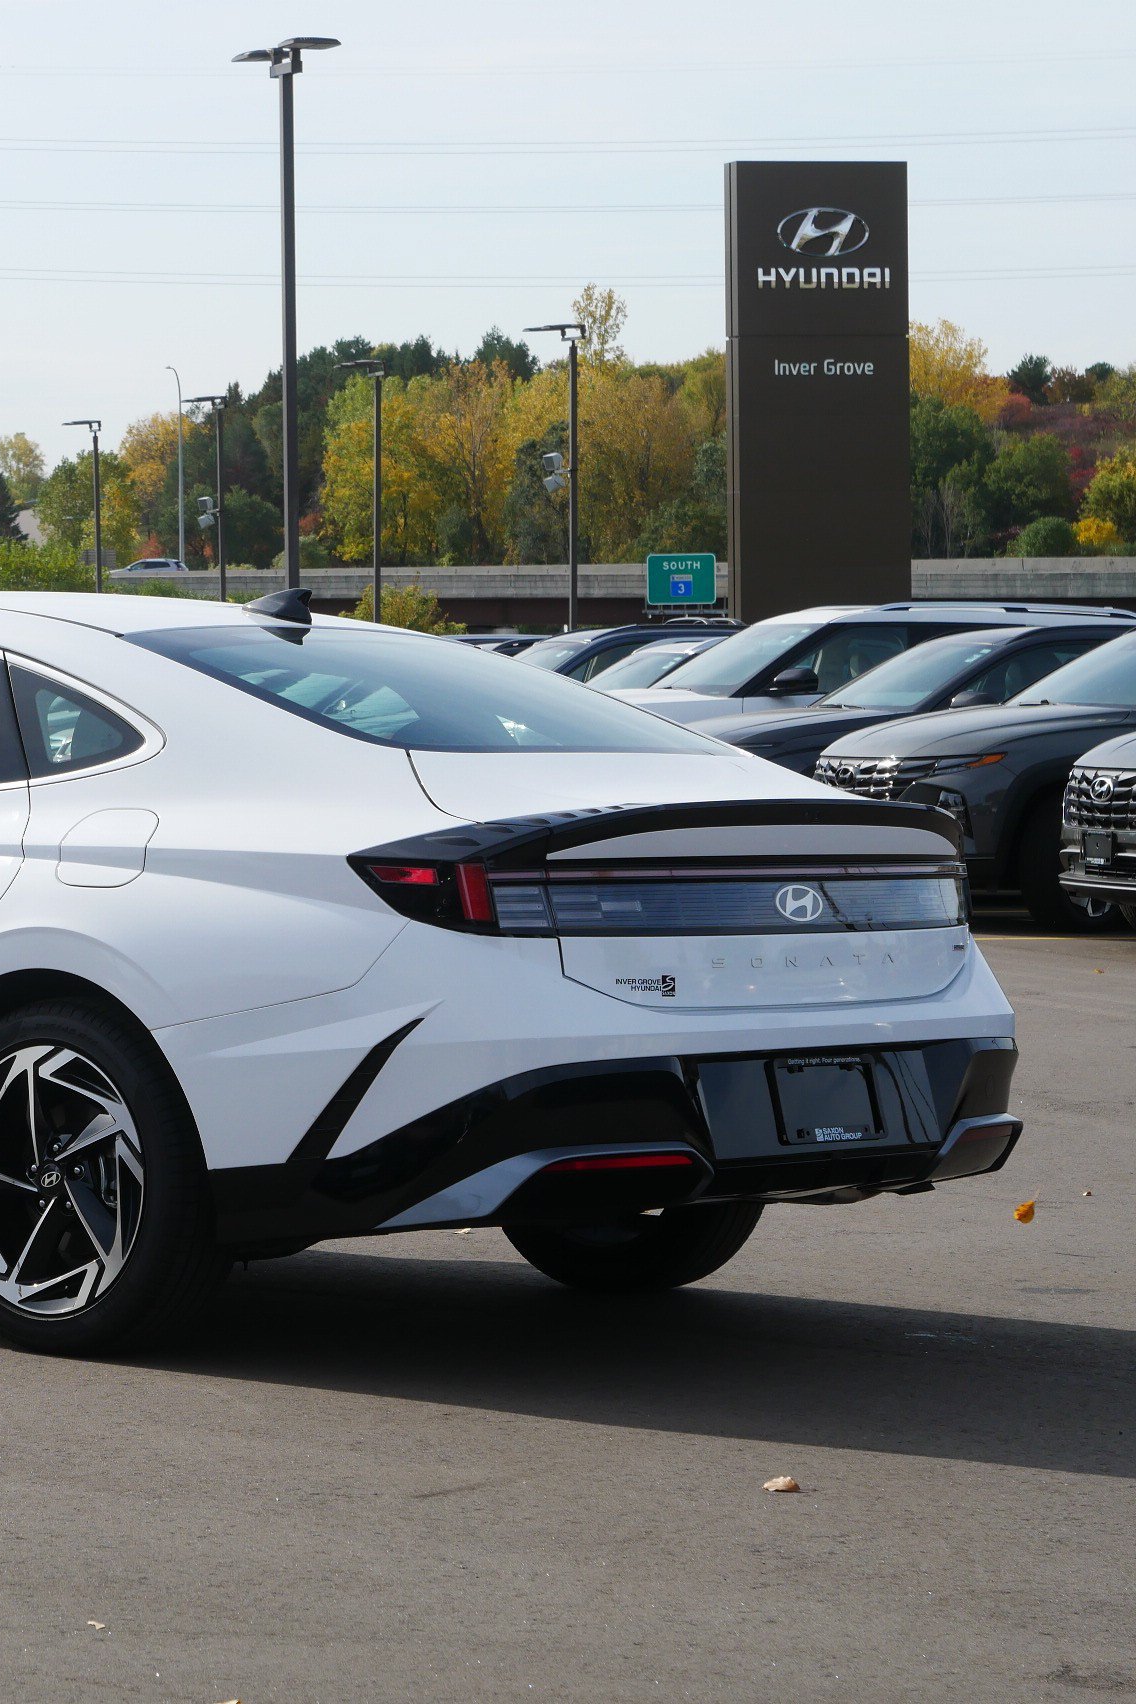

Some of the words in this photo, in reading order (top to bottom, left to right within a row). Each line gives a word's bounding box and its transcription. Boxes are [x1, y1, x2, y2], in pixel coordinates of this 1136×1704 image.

[757, 267, 891, 289] HYUNDAI
[774, 359, 817, 376] Inver
[823, 359, 875, 376] Grove
[662, 561, 701, 570] SOUTH
[677, 583, 685, 594] 3
[711, 953, 894, 968] SONATA
[841, 1132, 862, 1140] GROUP
